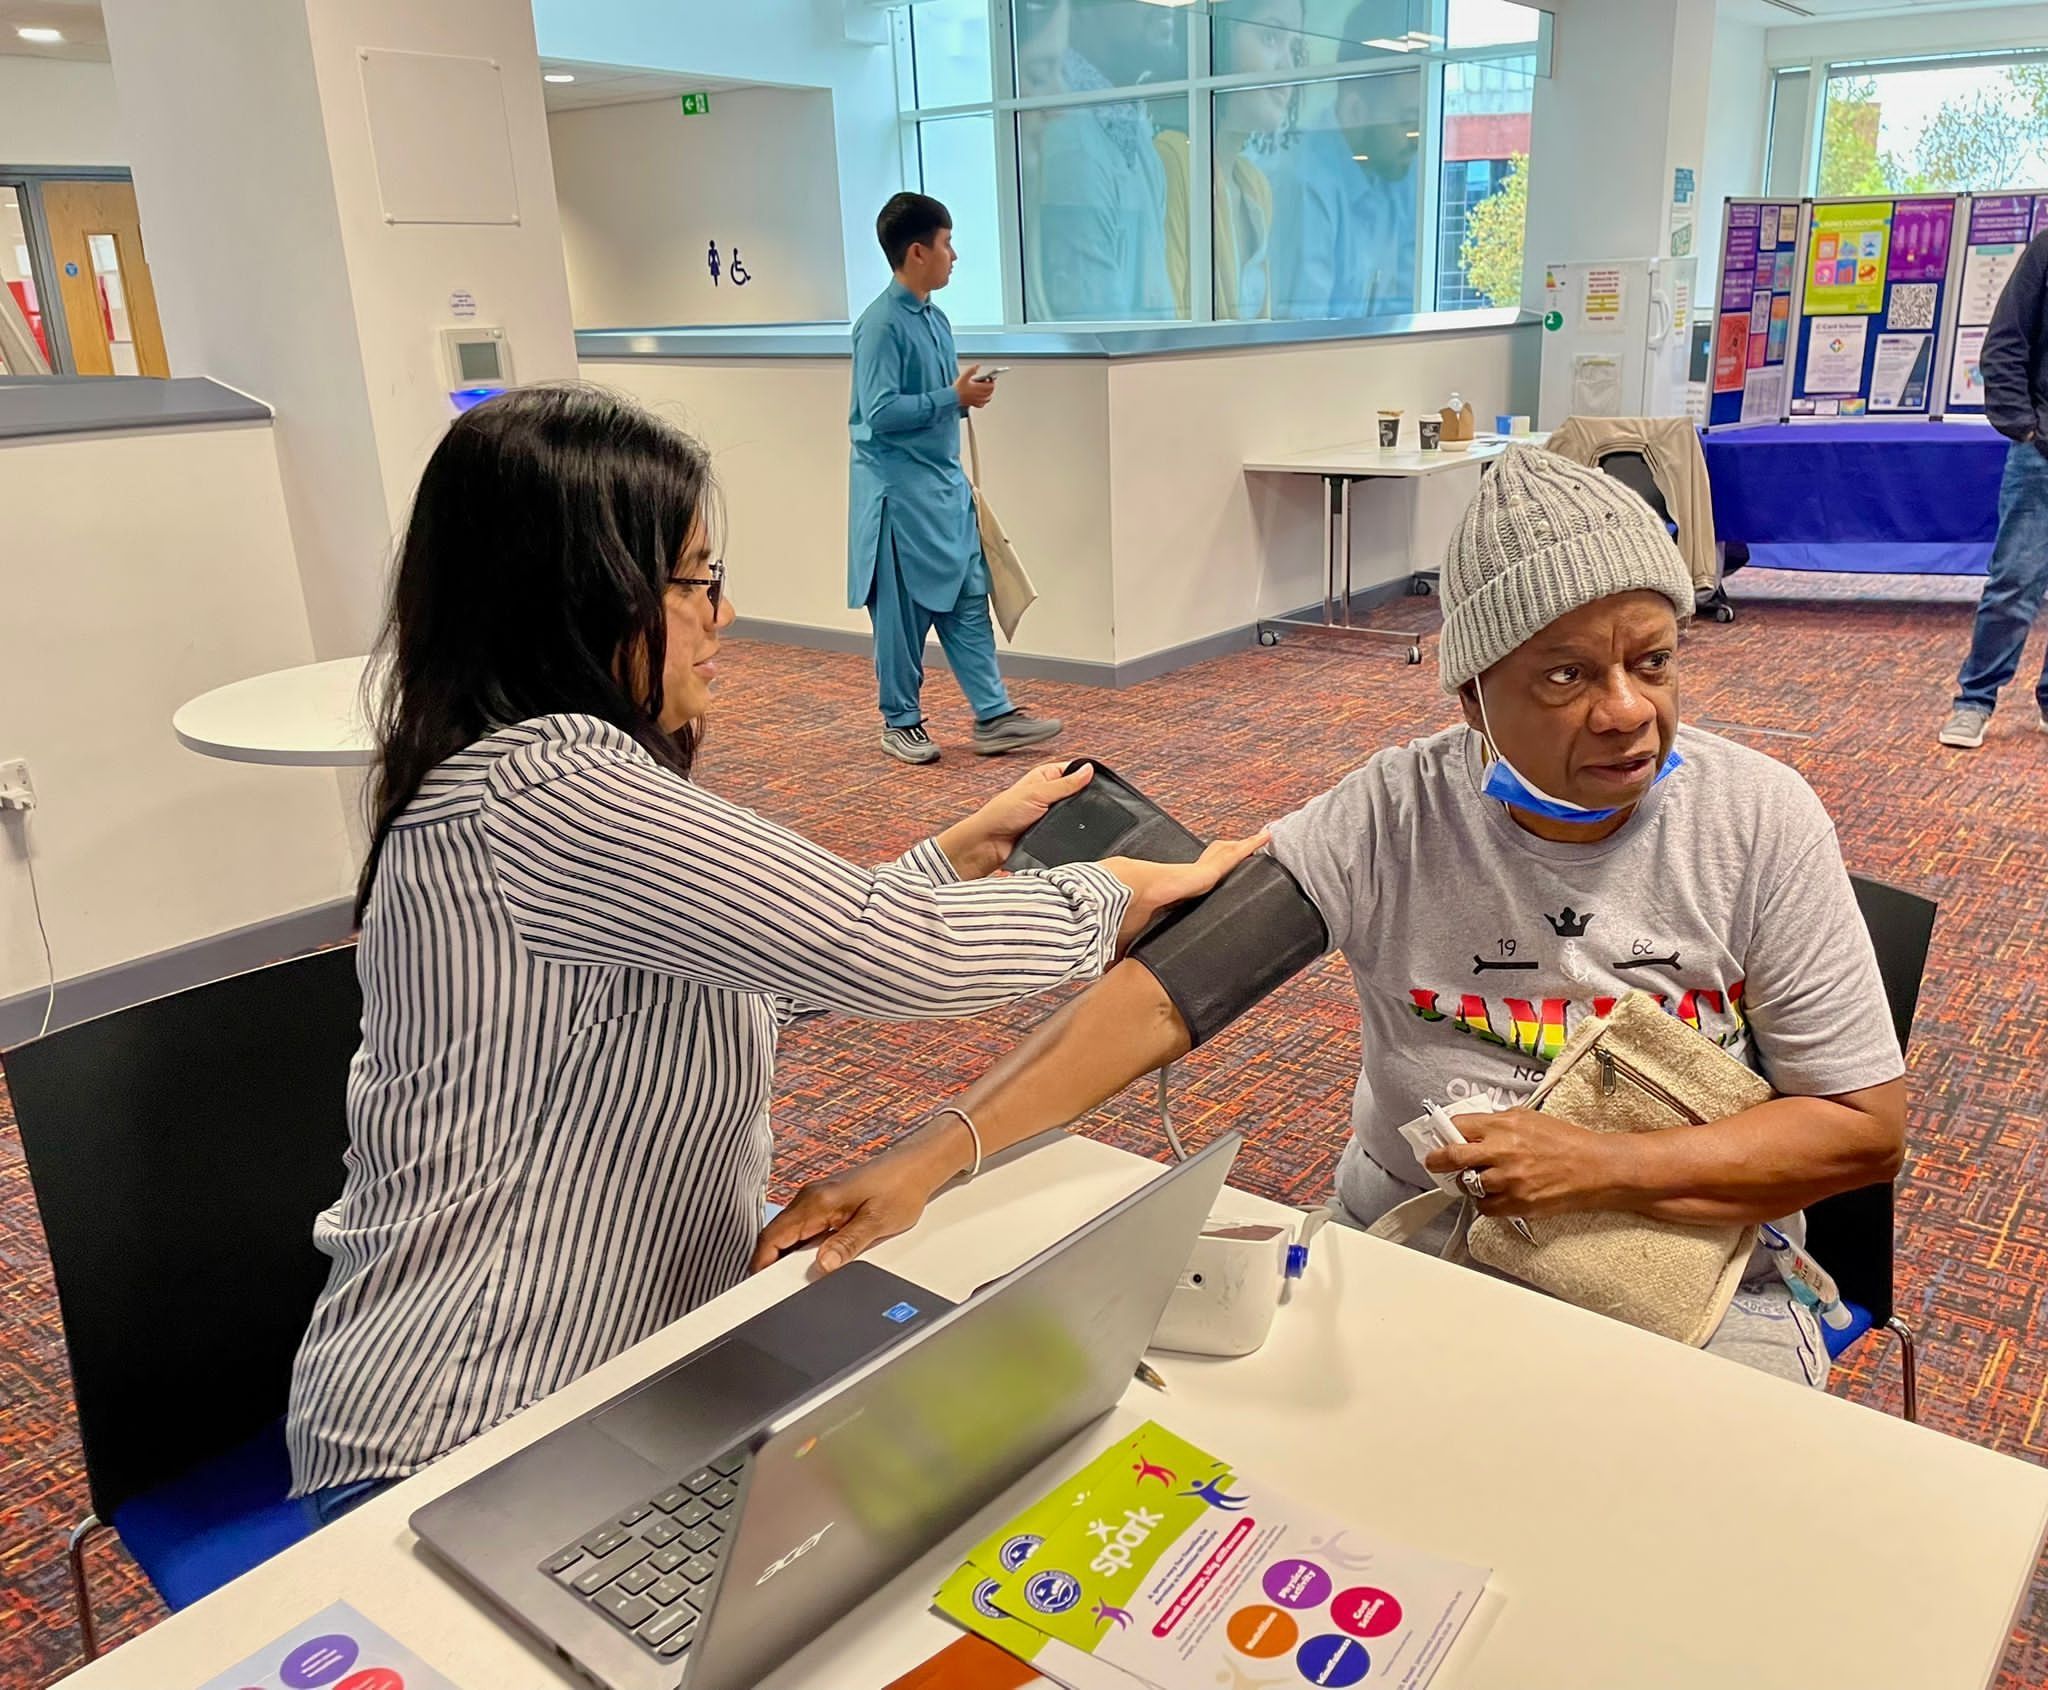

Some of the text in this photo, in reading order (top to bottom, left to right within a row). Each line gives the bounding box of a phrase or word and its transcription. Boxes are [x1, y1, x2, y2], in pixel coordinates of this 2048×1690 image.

[1497, 938, 1517, 956] 19
[1632, 938, 1654, 956] 62
[1089, 1505, 1164, 1578] spark
[1276, 1564, 1308, 1599] Physical
[1286, 1568, 1318, 1602] Activity
[1158, 1605, 1182, 1628] Small
[1349, 1598, 1372, 1620] Goal
[1243, 1610, 1279, 1650] Nutrition
[1313, 1637, 1352, 1685] Mindfulness
